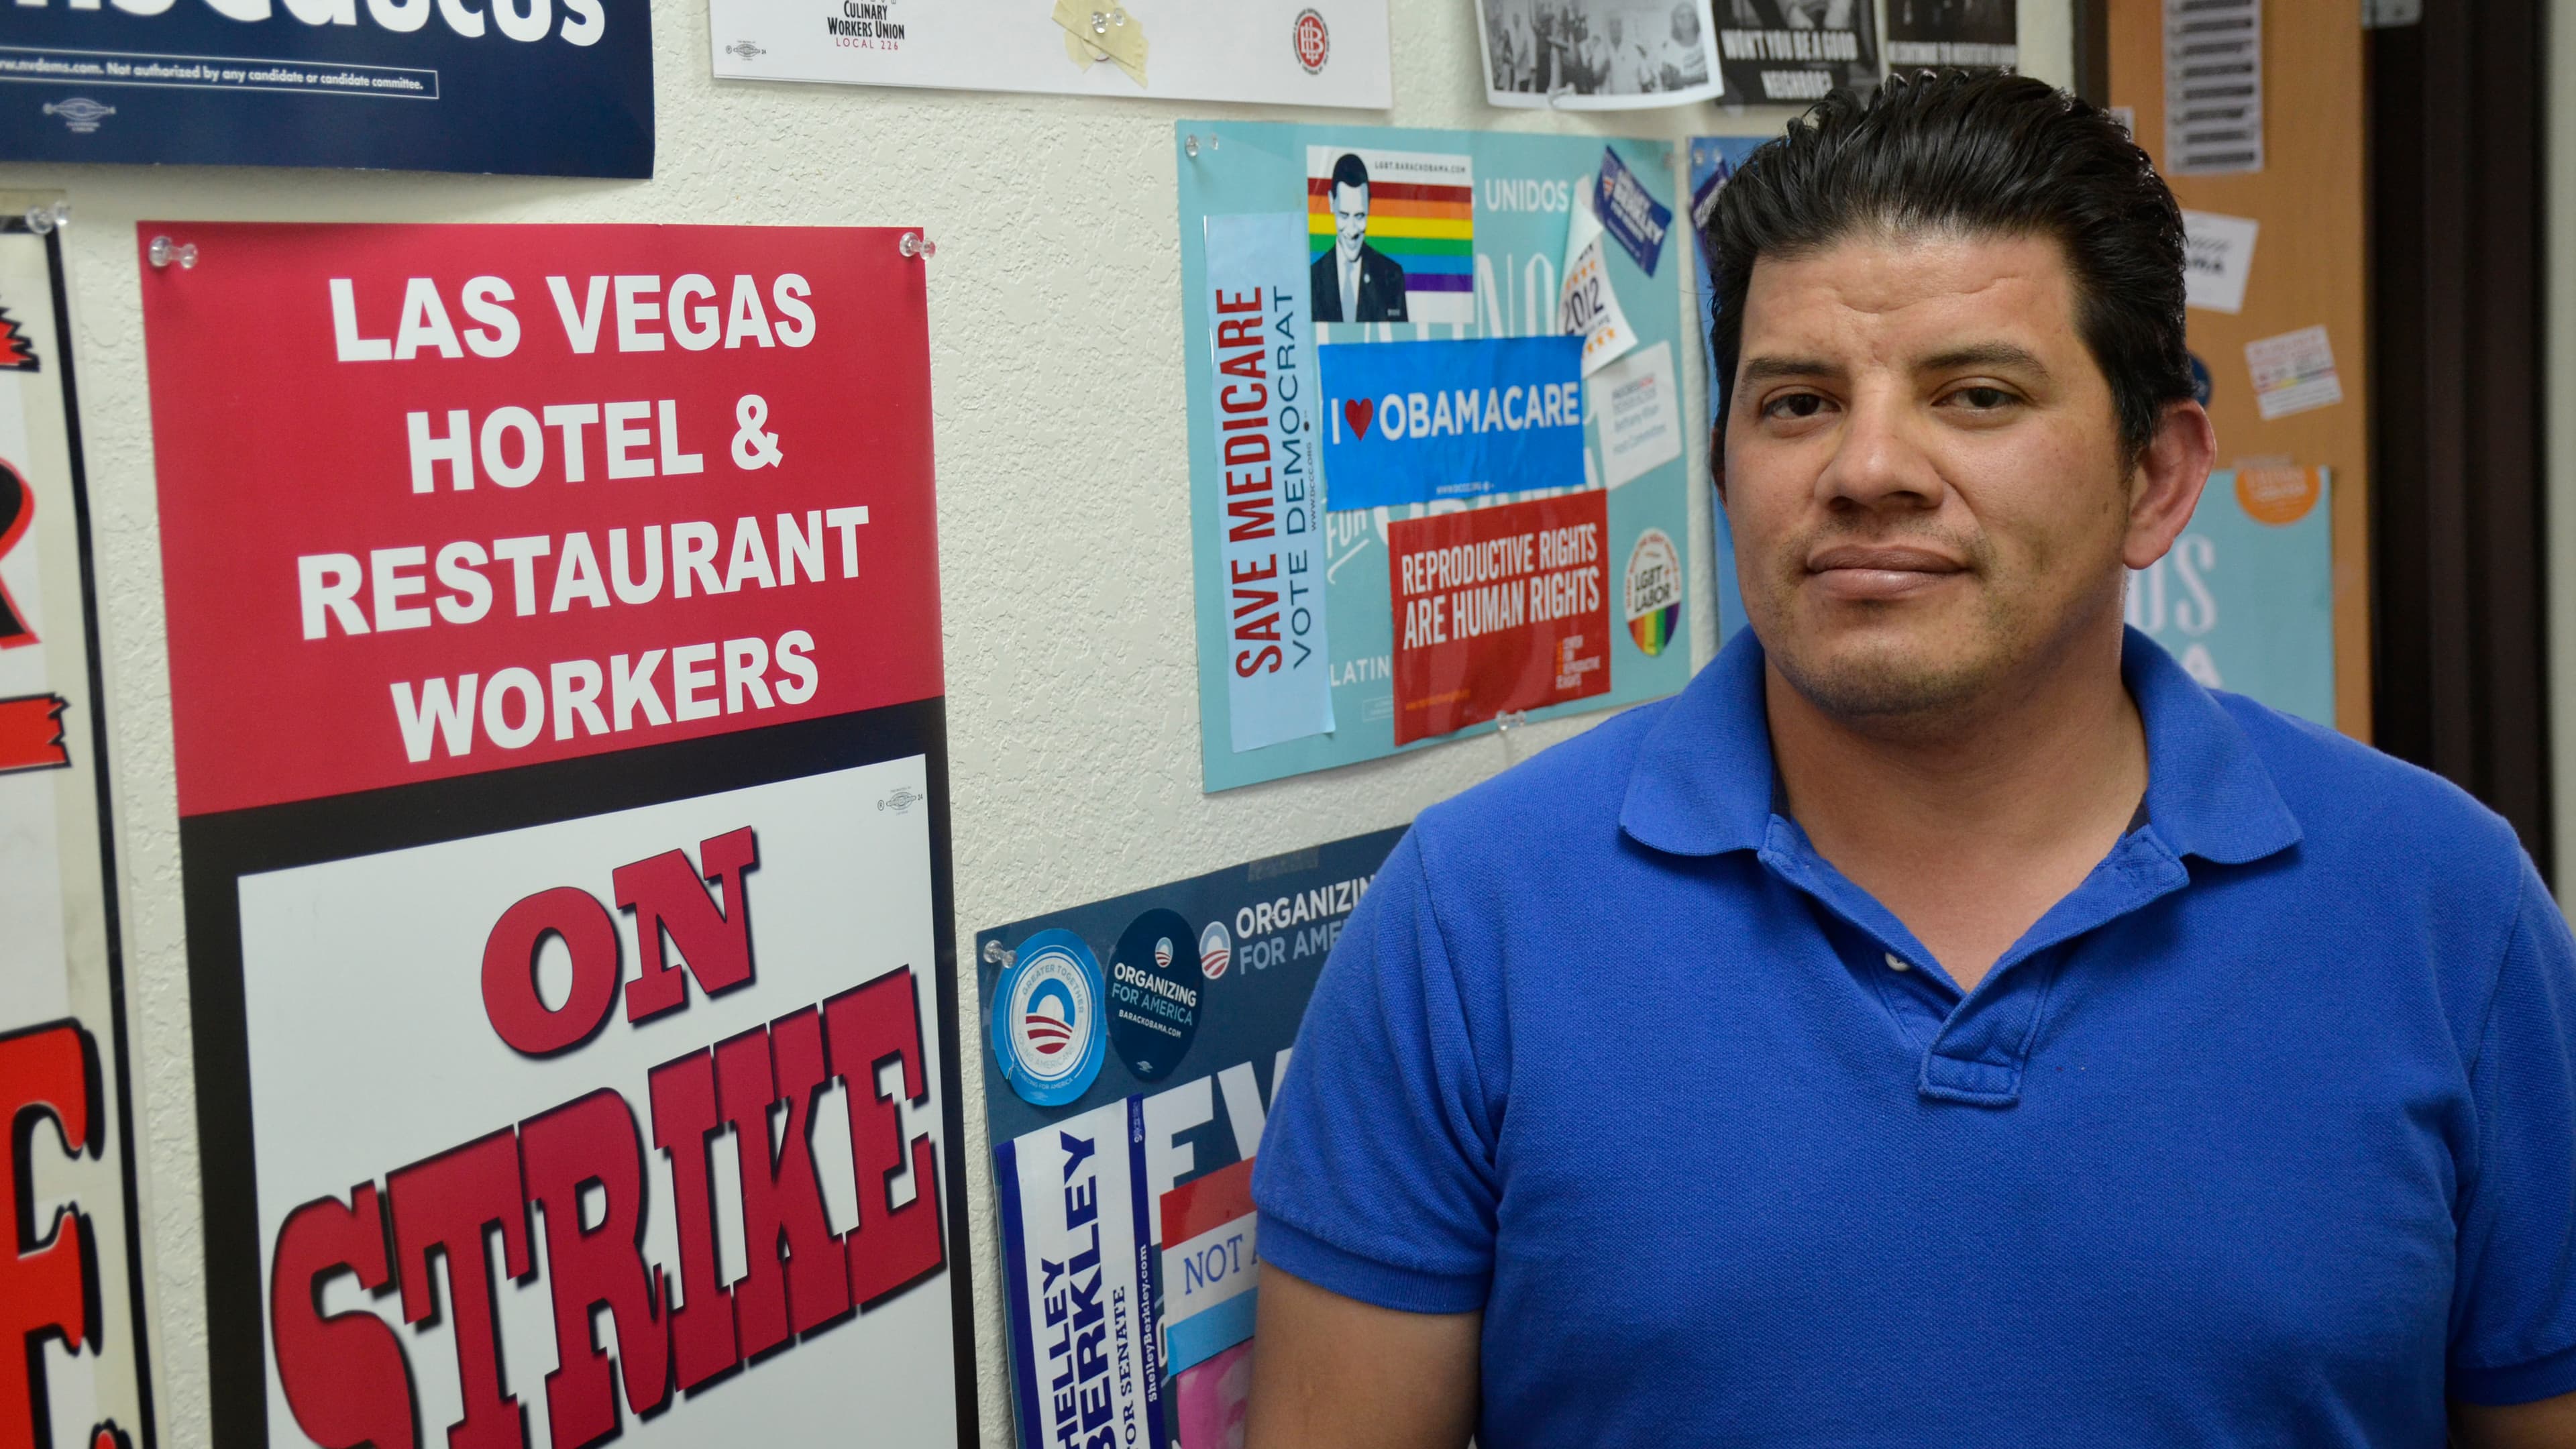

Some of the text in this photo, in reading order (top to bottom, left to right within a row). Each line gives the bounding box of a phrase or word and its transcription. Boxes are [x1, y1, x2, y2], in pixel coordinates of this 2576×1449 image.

[827, 17, 904, 40] WORKERS UNION
[844, 0, 887, 20] CULINARY
[836, 38, 898, 50] LOCAL 226
[106, 61, 131, 75] Not
[133, 63, 201, 78] authorized
[203, 65, 219, 82] by
[223, 69, 246, 83] any
[248, 68, 304, 83] candidate
[306, 72, 318, 83] or
[321, 72, 370, 87] candidate
[372, 76, 424, 89] committee.
[1374, 161, 1466, 174] LGBT.BARACKOBAMA.COM
[1485, 178, 1570, 213] UNIDOS
[329, 274, 816, 362] LAS VEGAS
[1562, 277, 1604, 335] 2012
[1332, 398, 1340, 445] I
[1379, 382, 1580, 441] OBAMACARE
[407, 394, 783, 494] HOTEL &
[1216, 286, 1283, 678] SAVE MEDICARE
[1273, 286, 1312, 669] VOTE DEMOCRAT
[1304, 441, 1317, 531] WWW.DCCC.ORG
[298, 506, 869, 640] RESTAURANT
[1401, 533, 1535, 596] REPRODUCTIVE
[1539, 522, 1597, 570] RIGHTS
[1634, 564, 1663, 592] LGBT
[1403, 594, 1447, 650] ARE
[1452, 579, 1525, 641] HUMAN
[1529, 566, 1601, 624] RIGHTS
[1635, 582, 1670, 612] LABOR
[390, 629, 818, 762] WORKERS
[481, 825, 758, 1060] ON
[1240, 918, 1347, 975] FOR AME
[1022, 964, 1084, 1014] GREATER TOGETHER
[1112, 982, 1193, 1026] FOR AMERICA
[1114, 962, 1197, 1008] ORGANIZING
[1018, 1032, 1077, 1069] YOUNG AMERICANS
[1118, 1009, 1181, 1038] BARACKOBAMA.COM
[270, 963, 947, 1449] STRIKE
[1183, 1233, 1243, 1295] NOT
[1113, 1285, 1132, 1397] SENATE
[1140, 1244, 1157, 1403] ShelleyBerkley.com
